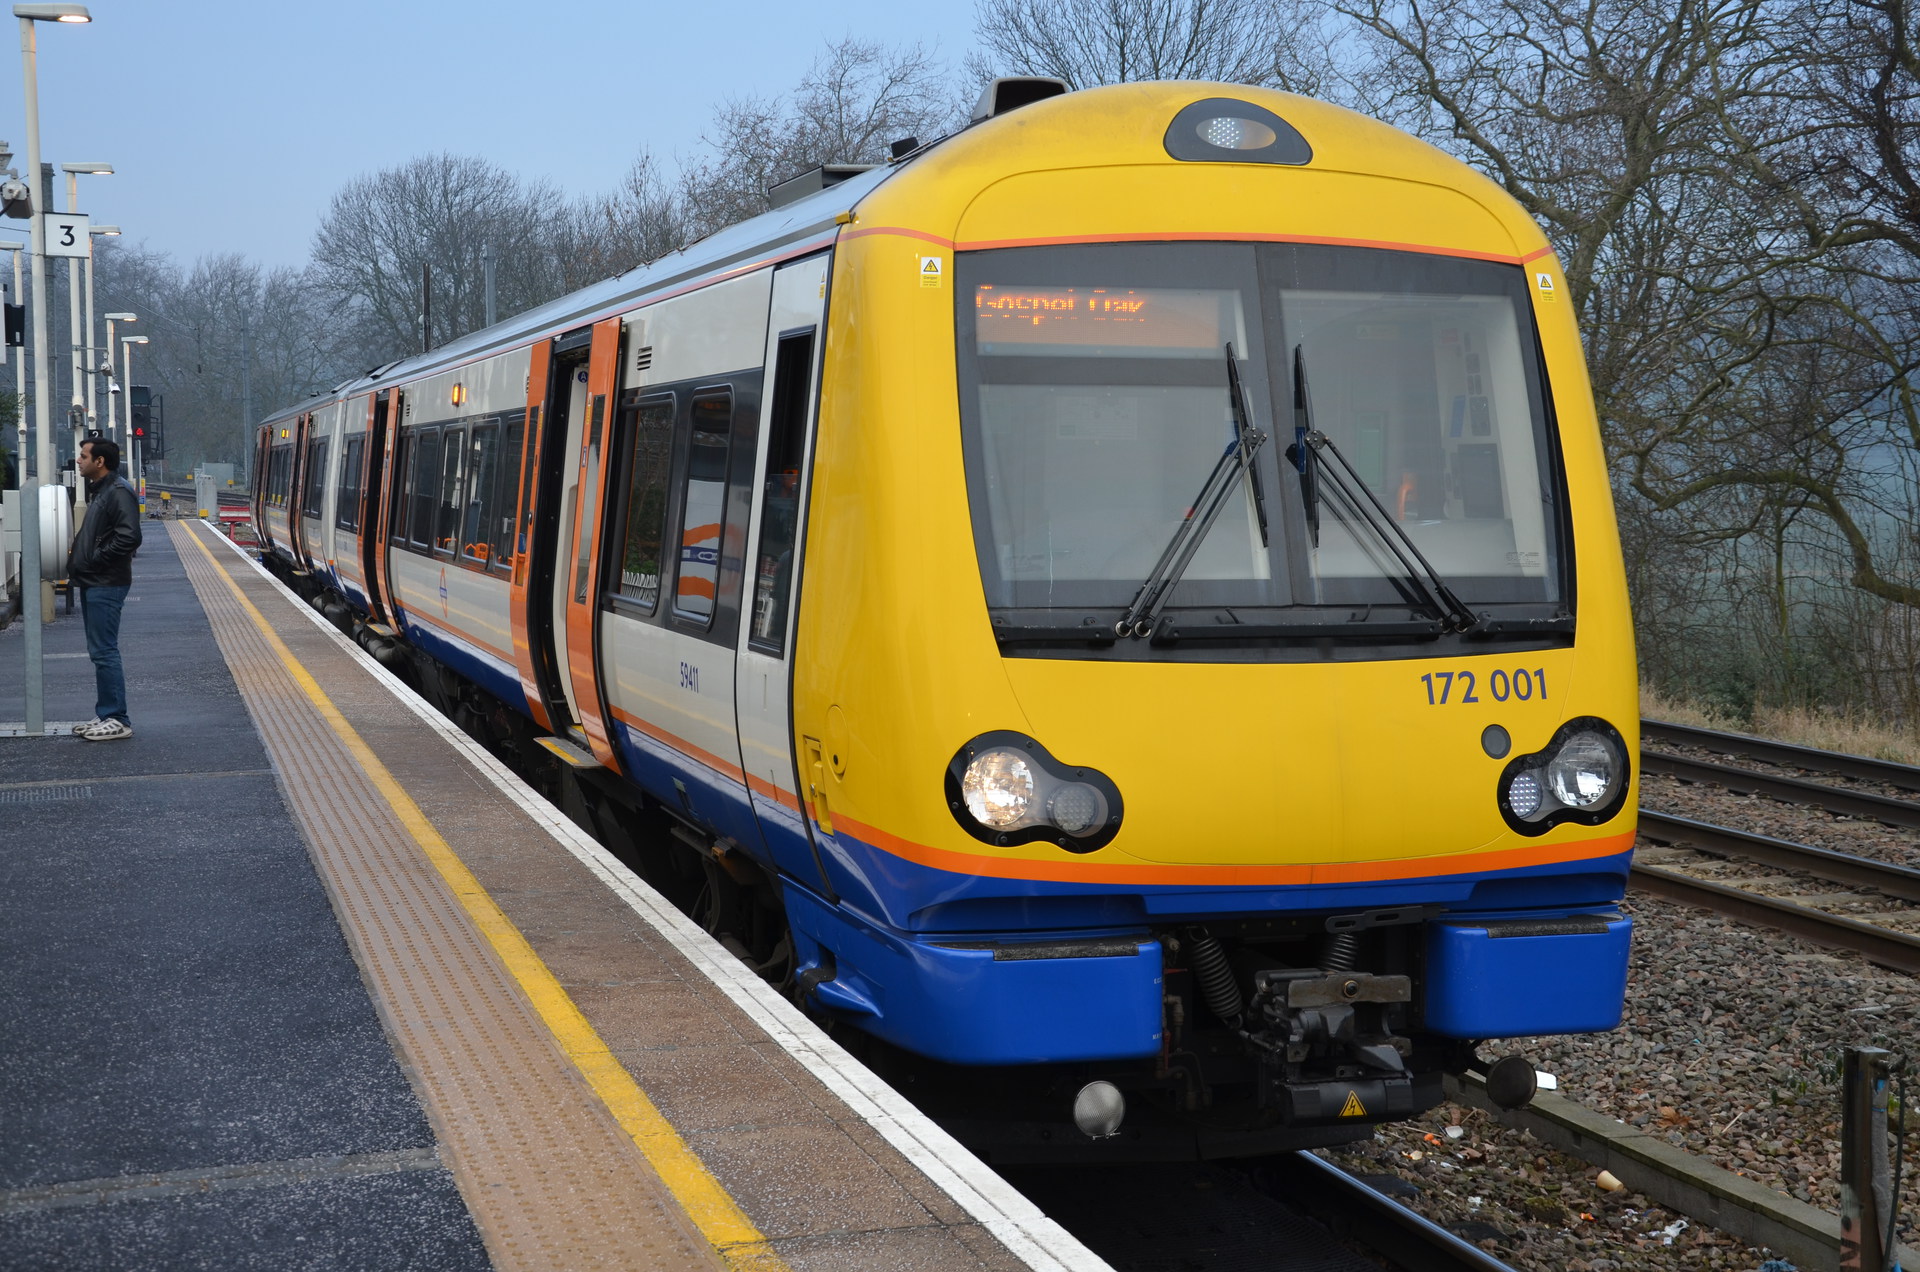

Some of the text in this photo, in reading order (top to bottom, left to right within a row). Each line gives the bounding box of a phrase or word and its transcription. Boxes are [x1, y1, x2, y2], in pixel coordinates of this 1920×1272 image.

[60, 225, 75, 247] 3
[680, 661, 699, 694] 59411
[1420, 667, 1548, 705] 172 001
